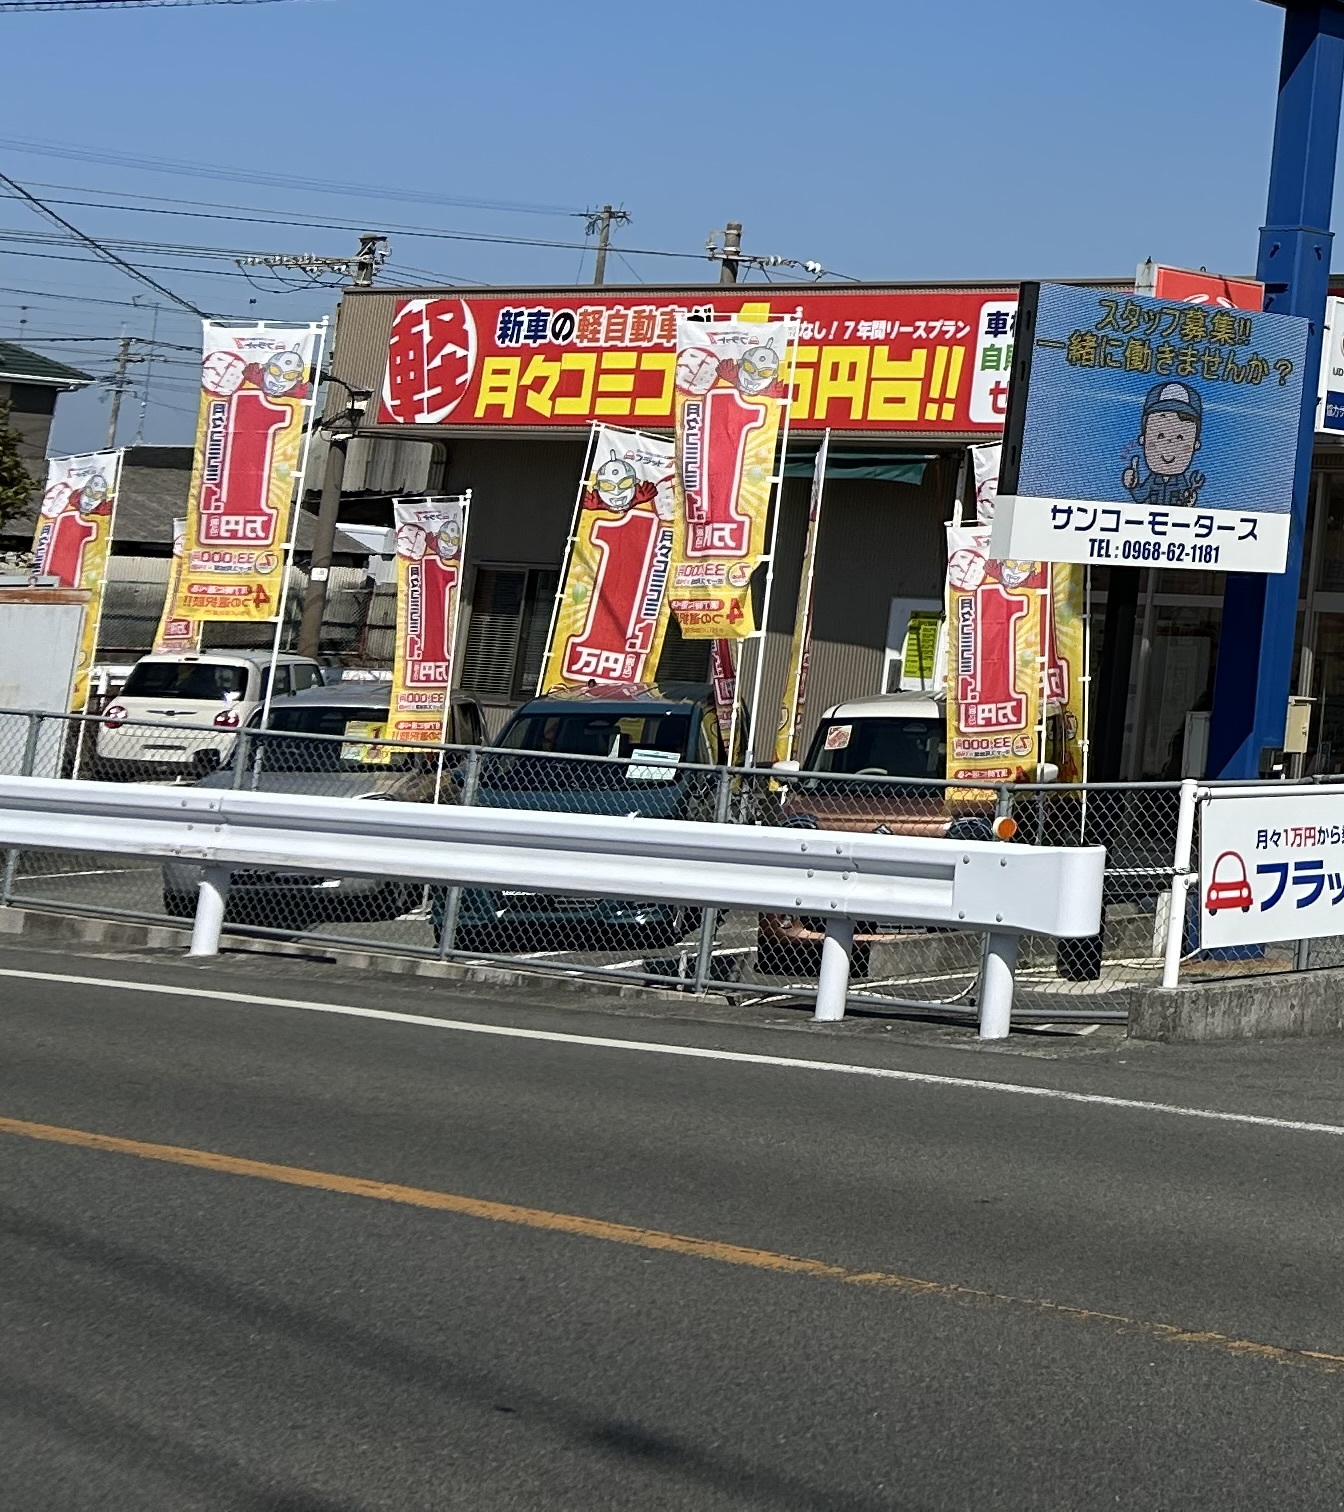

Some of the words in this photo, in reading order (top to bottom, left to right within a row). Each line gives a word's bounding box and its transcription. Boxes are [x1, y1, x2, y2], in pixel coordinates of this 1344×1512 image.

[1096, 299, 1253, 346] スタッフ募集!!
[387, 299, 477, 423] 軽
[1332, 366, 1344, 378] UD
[1051, 504, 1258, 541] サンコーモータース
[572, 646, 626, 678] 万円
